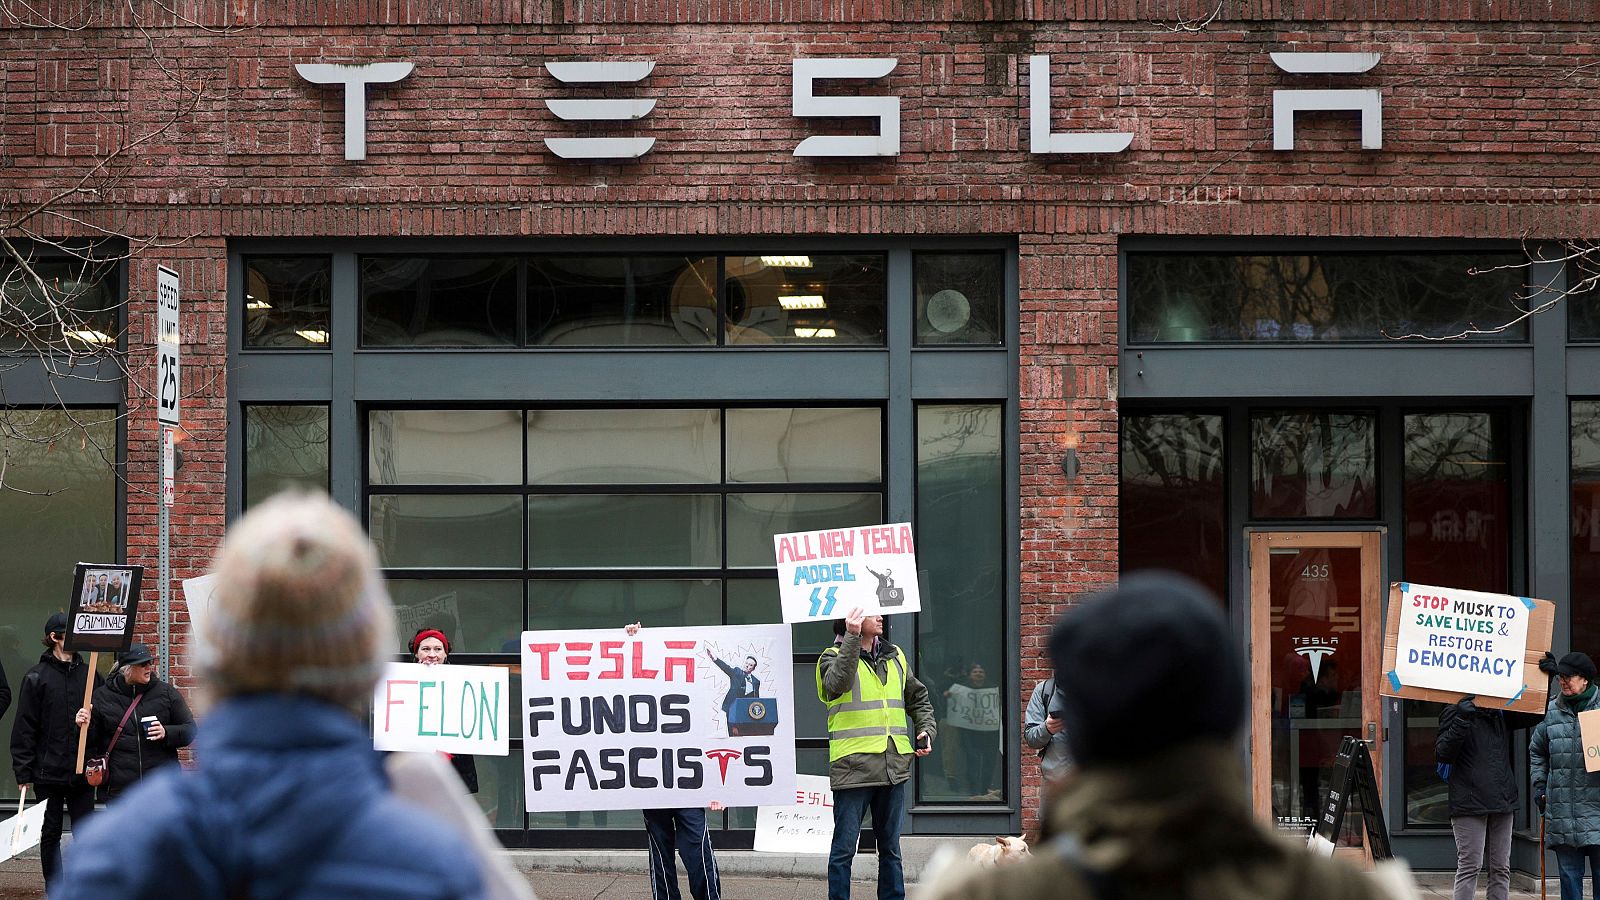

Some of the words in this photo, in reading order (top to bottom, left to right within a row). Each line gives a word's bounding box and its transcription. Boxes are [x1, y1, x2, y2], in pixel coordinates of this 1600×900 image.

[294, 51, 1383, 162] TESLA
[160, 282, 178, 311] SPEED
[161, 318, 176, 344] LIMIT
[161, 353, 177, 411] 25
[778, 534, 817, 563] ALL
[819, 530, 855, 558] NEW
[860, 525, 914, 555] TESLA
[793, 562, 856, 585] MODEL
[1301, 564, 1329, 578] 435
[1412, 594, 1449, 611] STOP
[1453, 600, 1495, 618] MUSK
[1497, 605, 1516, 619] TO
[77, 614, 126, 630] CRIMINALS
[1415, 613, 1453, 629] SAVE
[1456, 617, 1494, 634] LIVES
[1497, 622, 1509, 636] &
[1292, 637, 1339, 645] TESLA
[1428, 634, 1493, 652] RESTORE
[528, 641, 697, 683] TESLA
[1408, 648, 1517, 677] DEMOCRACY
[384, 680, 500, 741] FELON
[529, 694, 691, 738] FUNDS
[532, 746, 773, 791] FASCISTS
